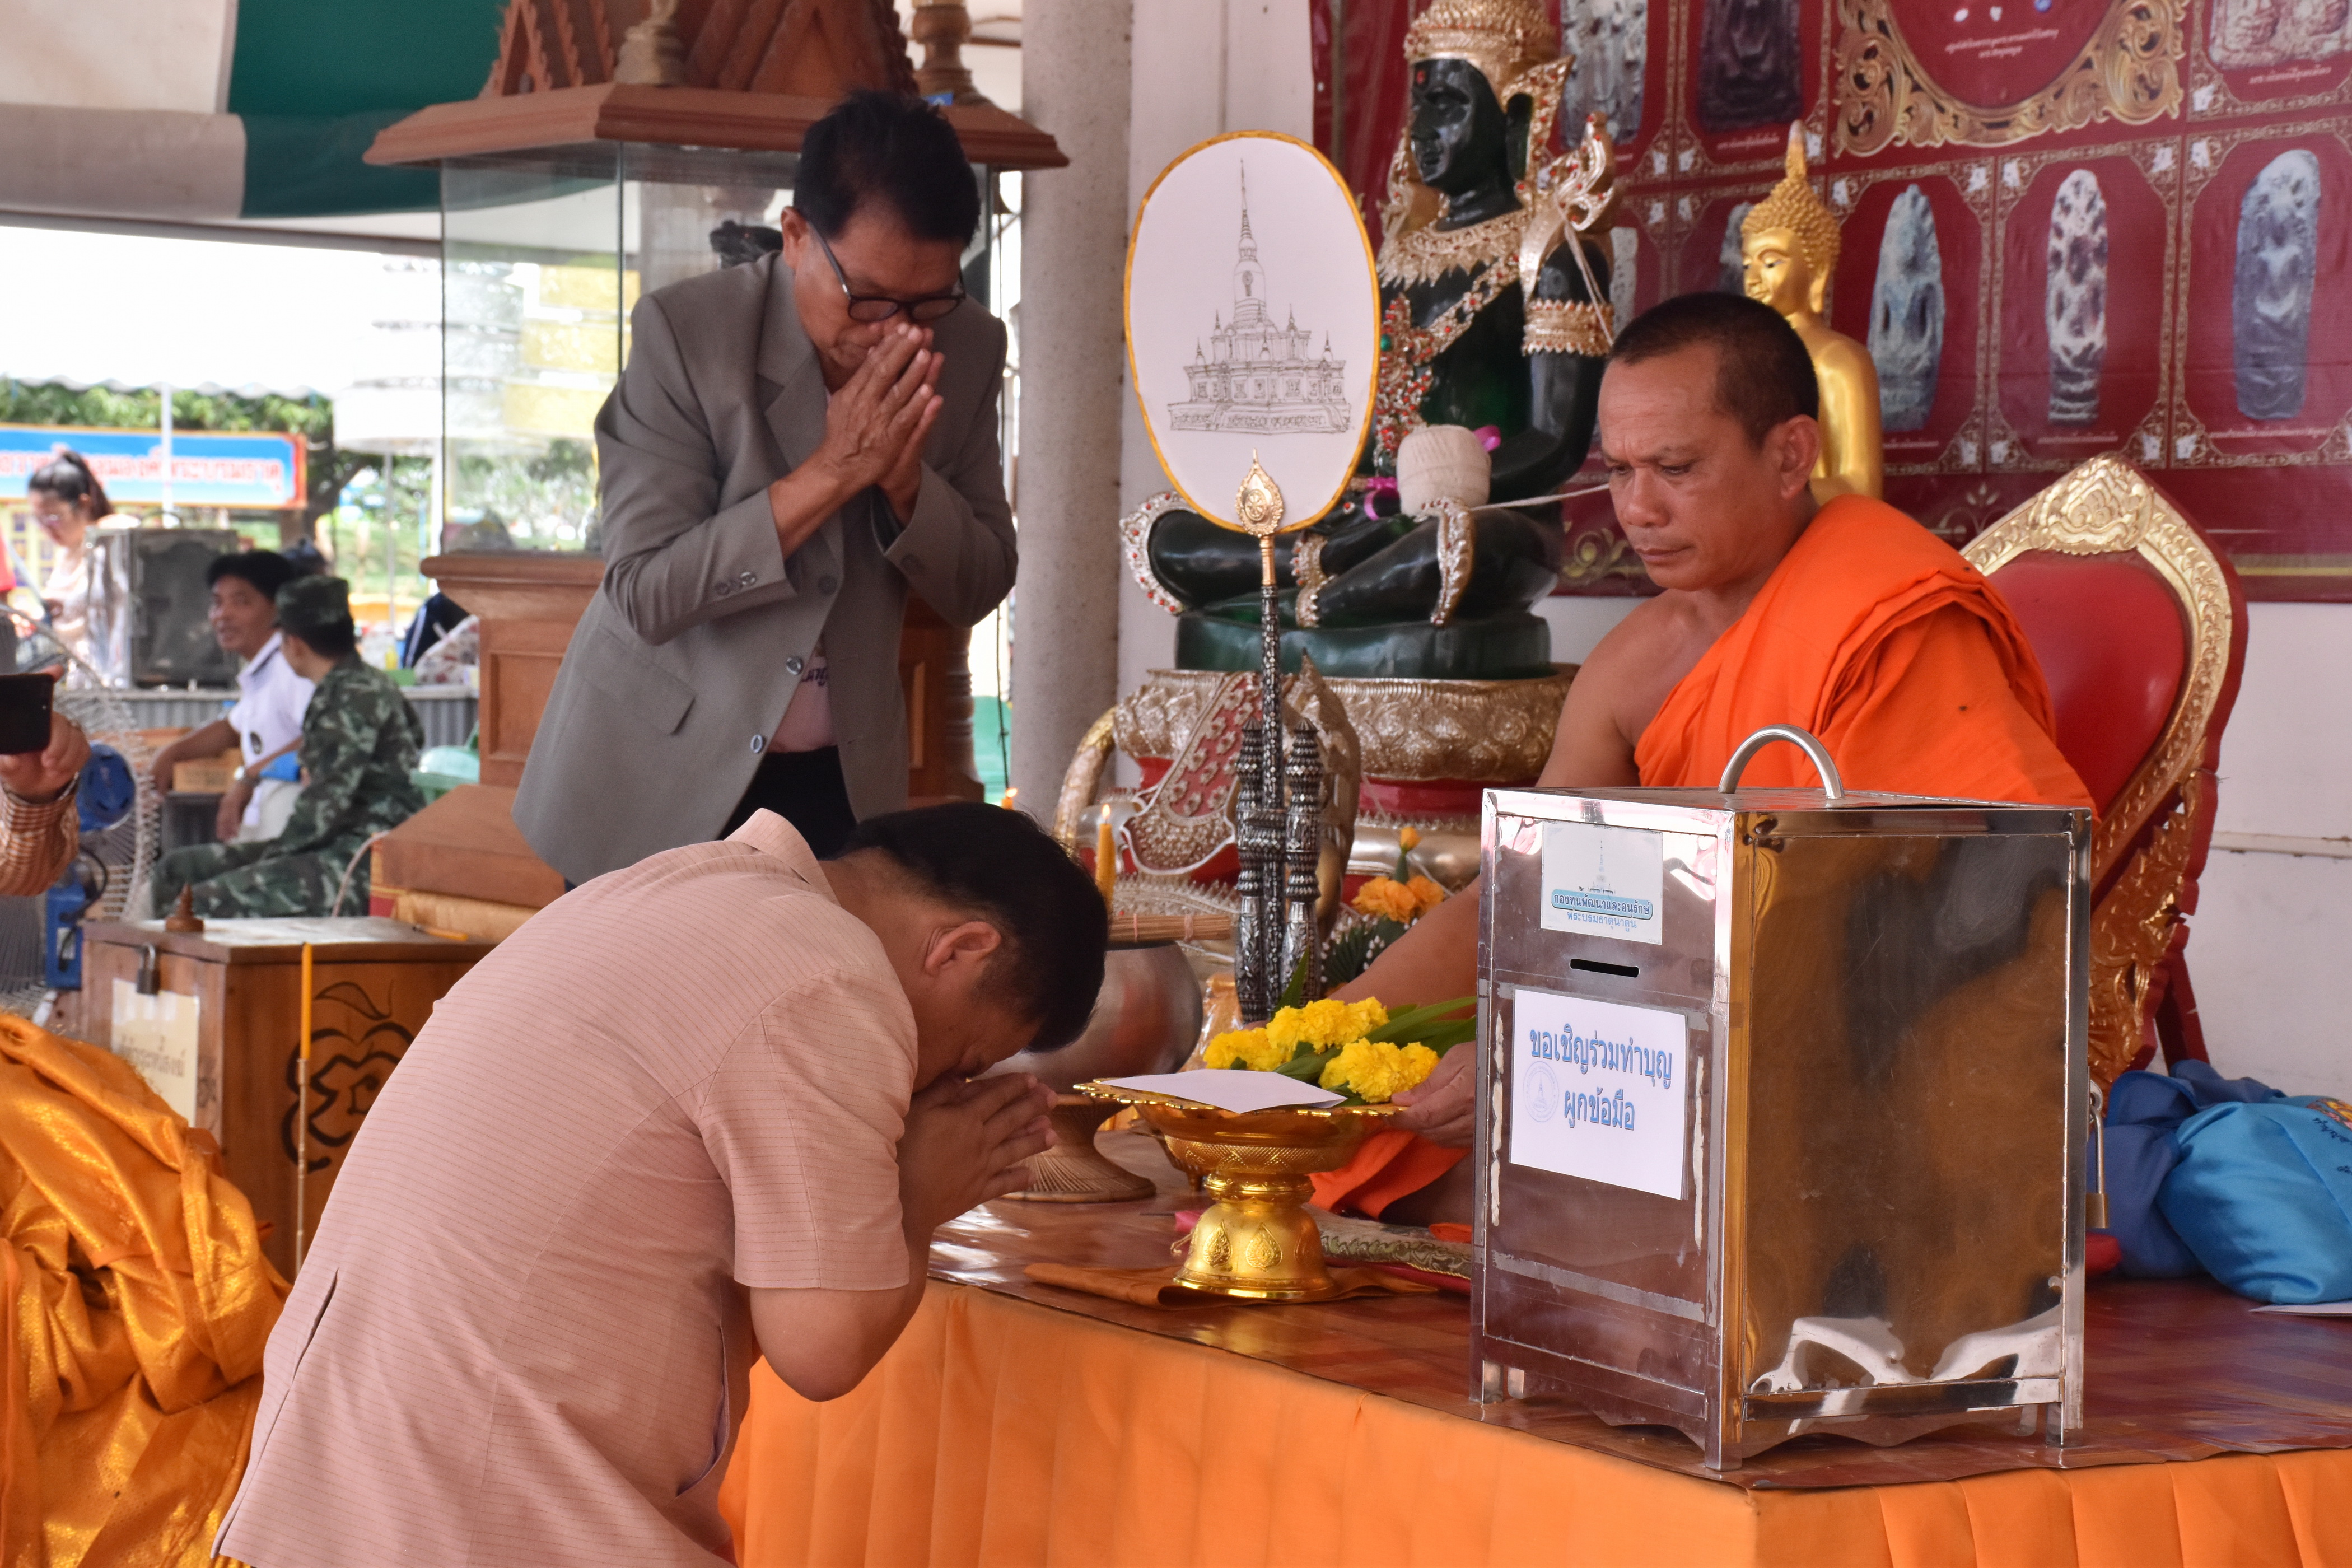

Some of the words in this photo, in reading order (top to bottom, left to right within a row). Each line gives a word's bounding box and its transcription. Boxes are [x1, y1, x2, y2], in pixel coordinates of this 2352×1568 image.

[1553, 894, 1650, 918] กองทุนพัฒนาและอนุรักษ์
[1567, 911, 1637, 932] พระบรมธาตุนาดูน
[1529, 1023, 1672, 1089] ขอเชิญร่วมทำบุญ
[1564, 1086, 1635, 1131] ผูกข้อมือ
